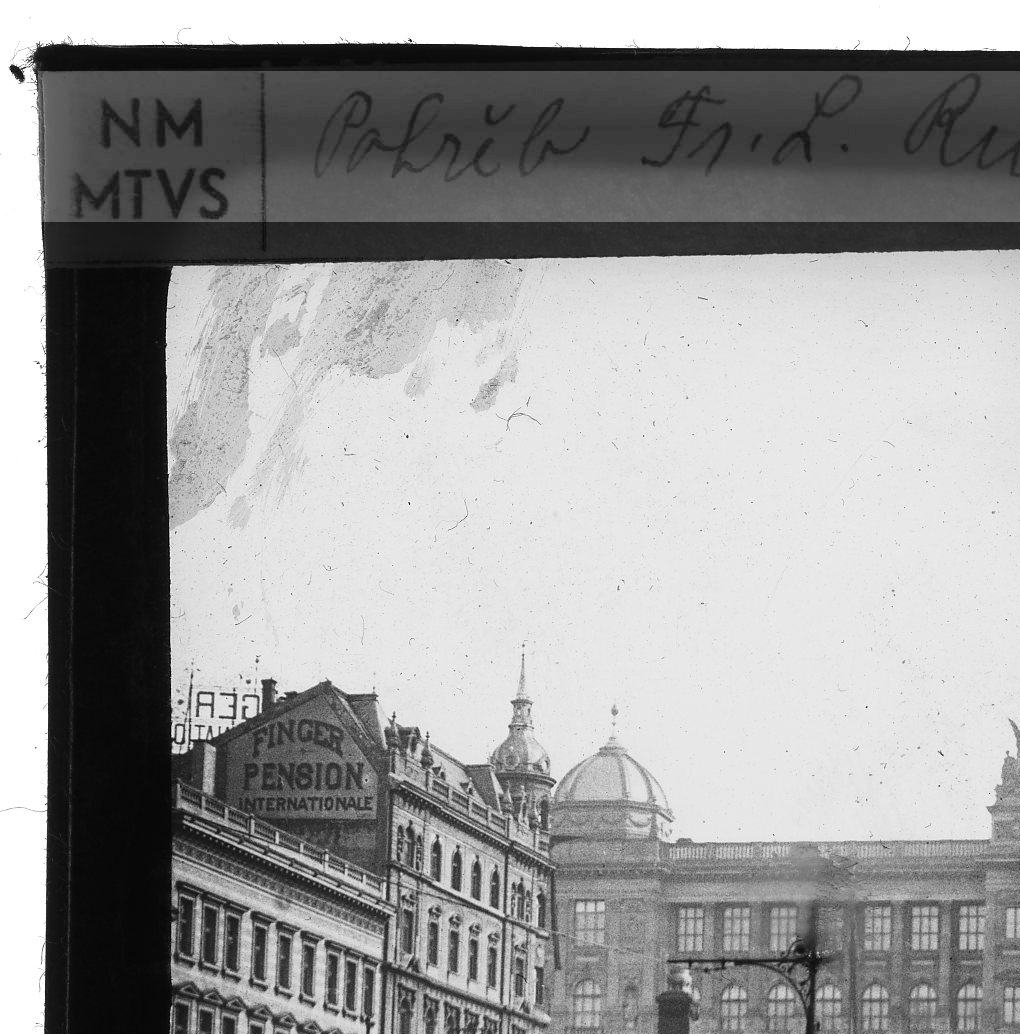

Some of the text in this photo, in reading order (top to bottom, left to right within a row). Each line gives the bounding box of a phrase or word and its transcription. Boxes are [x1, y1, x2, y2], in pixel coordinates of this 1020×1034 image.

[74, 167, 229, 220] MTVS
[252, 718, 345, 759] FINGER
[243, 762, 365, 791] PENSION
[239, 796, 373, 811] INTERNATIONALE
